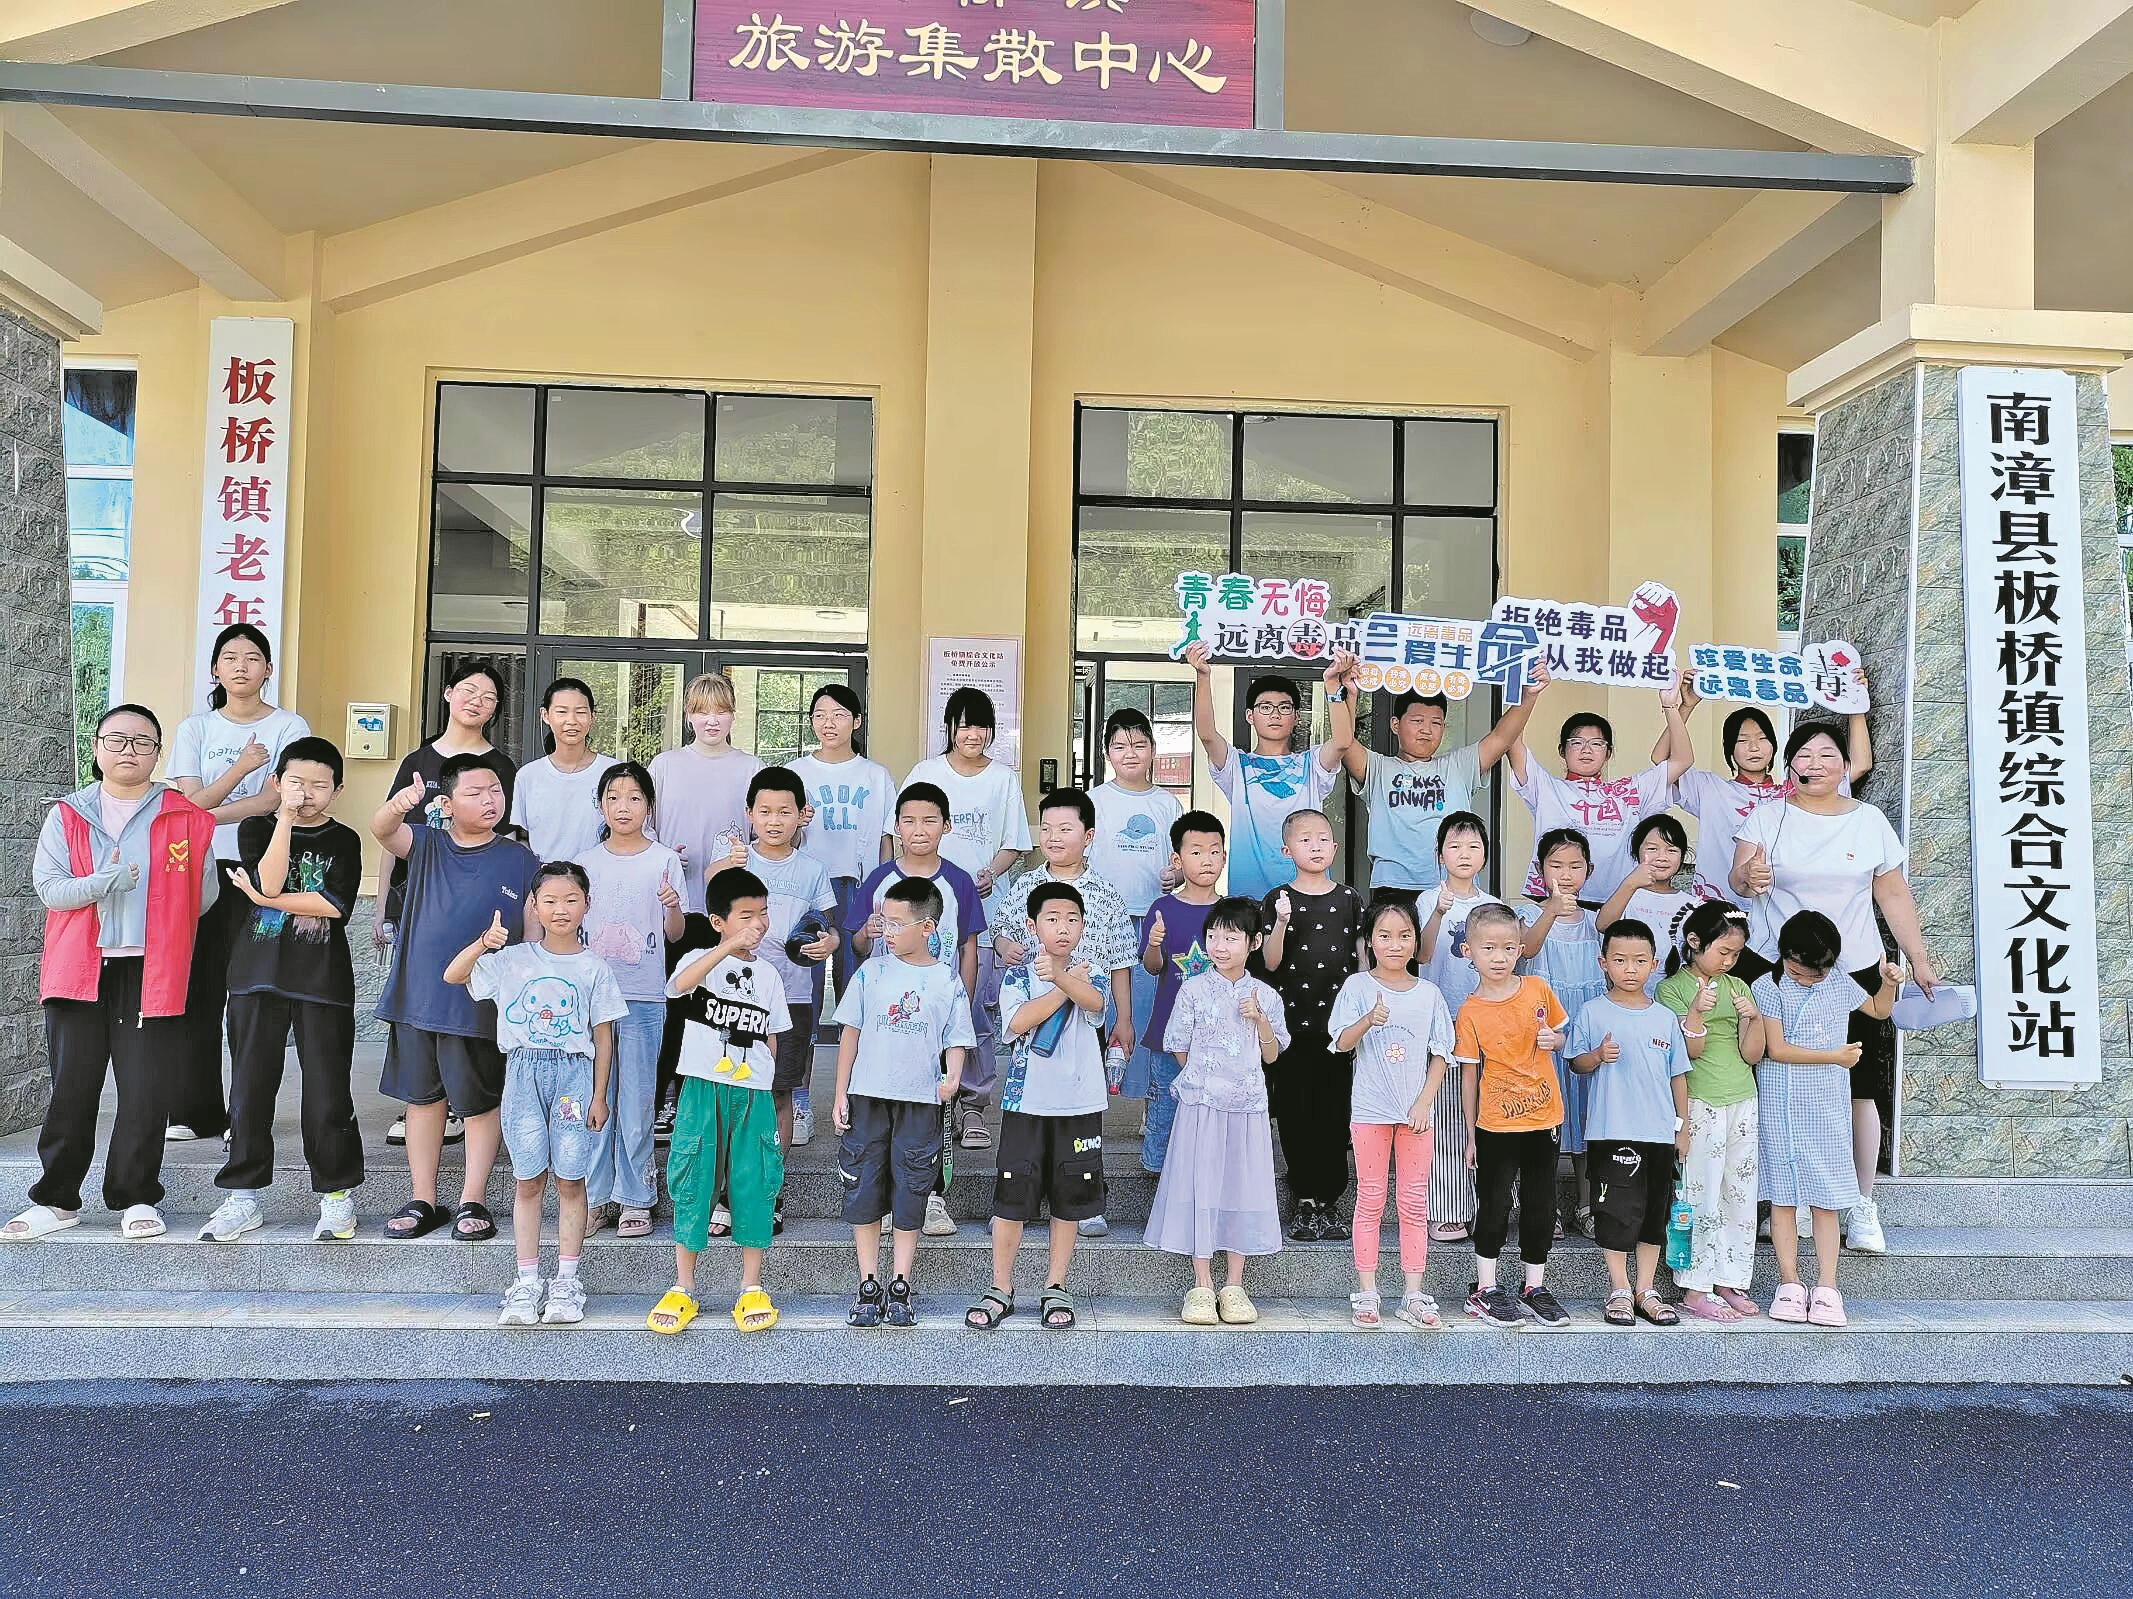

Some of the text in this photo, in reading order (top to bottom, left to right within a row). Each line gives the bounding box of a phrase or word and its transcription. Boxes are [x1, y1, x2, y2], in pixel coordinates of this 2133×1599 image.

[728, 13, 1229, 95] 旅游集散中心
[213, 356, 277, 627] 板桥镇老年
[1178, 573, 1327, 618] 青春无悔
[1213, 621, 1362, 657] 远离毒品
[1407, 622, 1474, 643] 远离毒品
[1501, 604, 1627, 643] 拒绝毒品
[1545, 643, 1670, 682] 从我做起
[1694, 648, 1803, 677] 珍爱生命
[1699, 674, 1809, 704] 远离毒品
[1986, 390, 2077, 1059] 南漳县板桥镇综合文化站
[822, 806, 858, 831] K.L.
